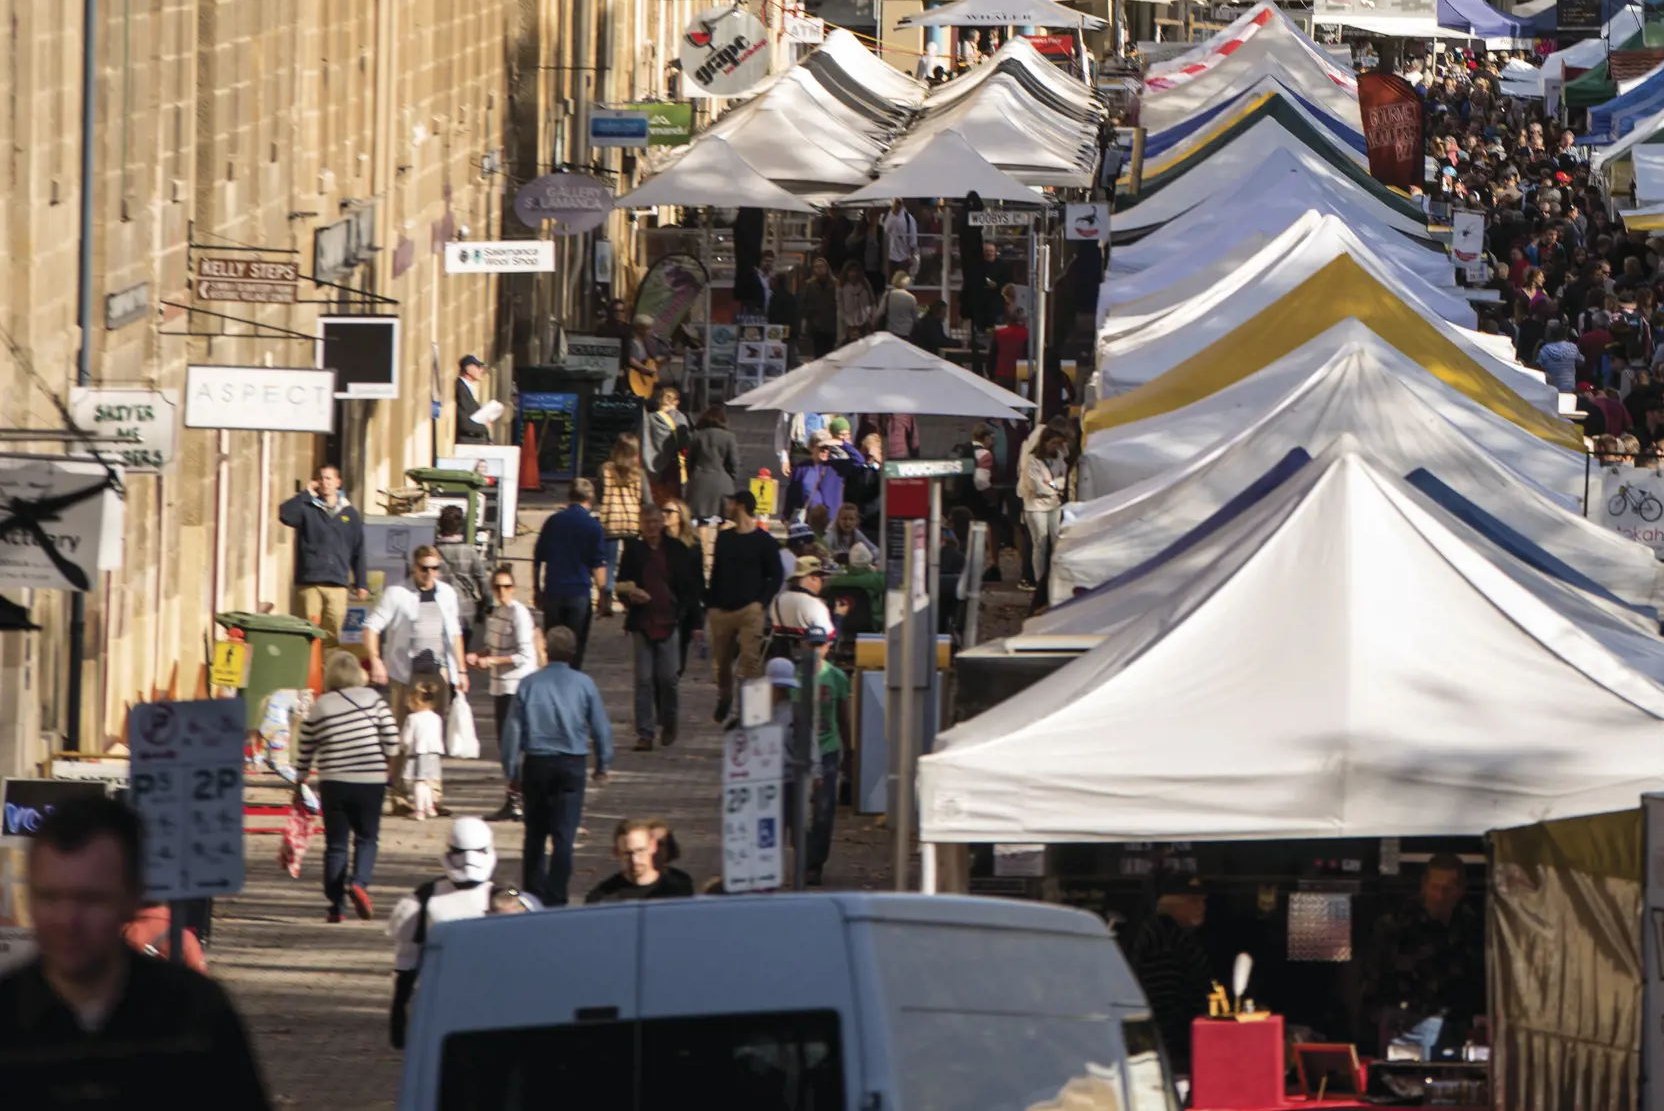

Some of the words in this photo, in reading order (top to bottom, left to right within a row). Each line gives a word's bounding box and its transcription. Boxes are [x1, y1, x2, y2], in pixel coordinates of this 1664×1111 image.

[966, 13, 1034, 21] WHALER
[695, 35, 750, 86] grape
[1370, 104, 1418, 128] GOURMET
[546, 187, 600, 197] GALLERY
[524, 197, 602, 210] SALAMANCA
[484, 248, 538, 256] Salamanca
[484, 256, 509, 265] Wool
[513, 256, 538, 266] Shop
[201, 260, 246, 277] KELLY
[249, 263, 296, 281] STEPS
[195, 382, 325, 406] ASPECT
[94, 404, 155, 423] SHIVER
[117, 425, 138, 438] ME
[193, 768, 239, 802] 2P
